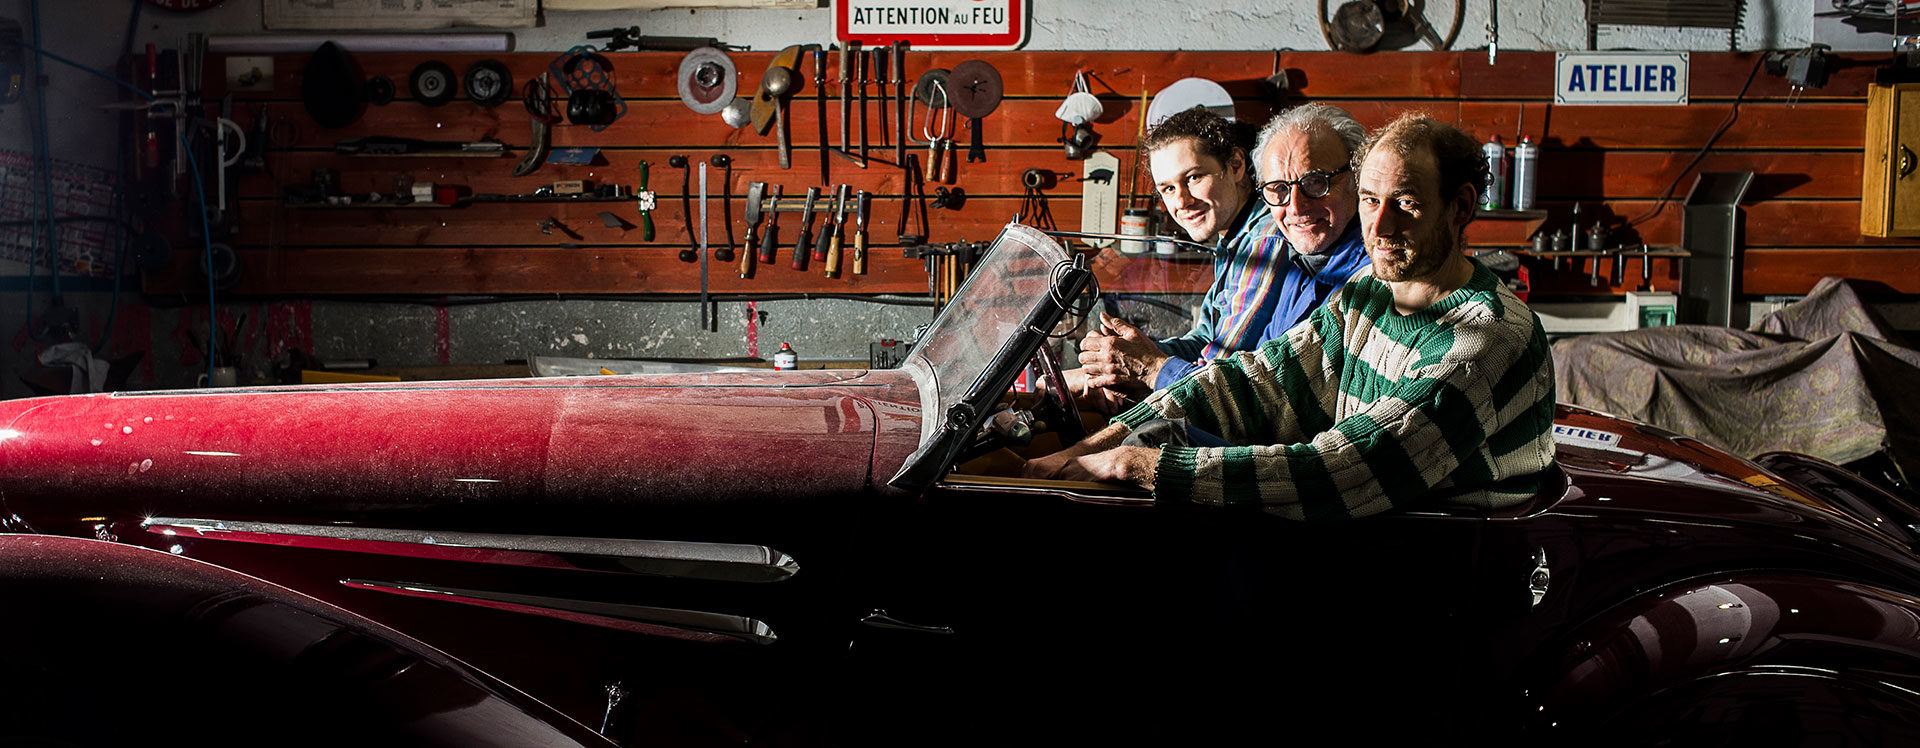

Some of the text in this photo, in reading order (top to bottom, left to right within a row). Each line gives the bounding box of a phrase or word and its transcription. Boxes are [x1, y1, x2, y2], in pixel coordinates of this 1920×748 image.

[854, 7, 1004, 25] ATTENTION AU FEU
[1568, 65, 1677, 92] ATELIER
